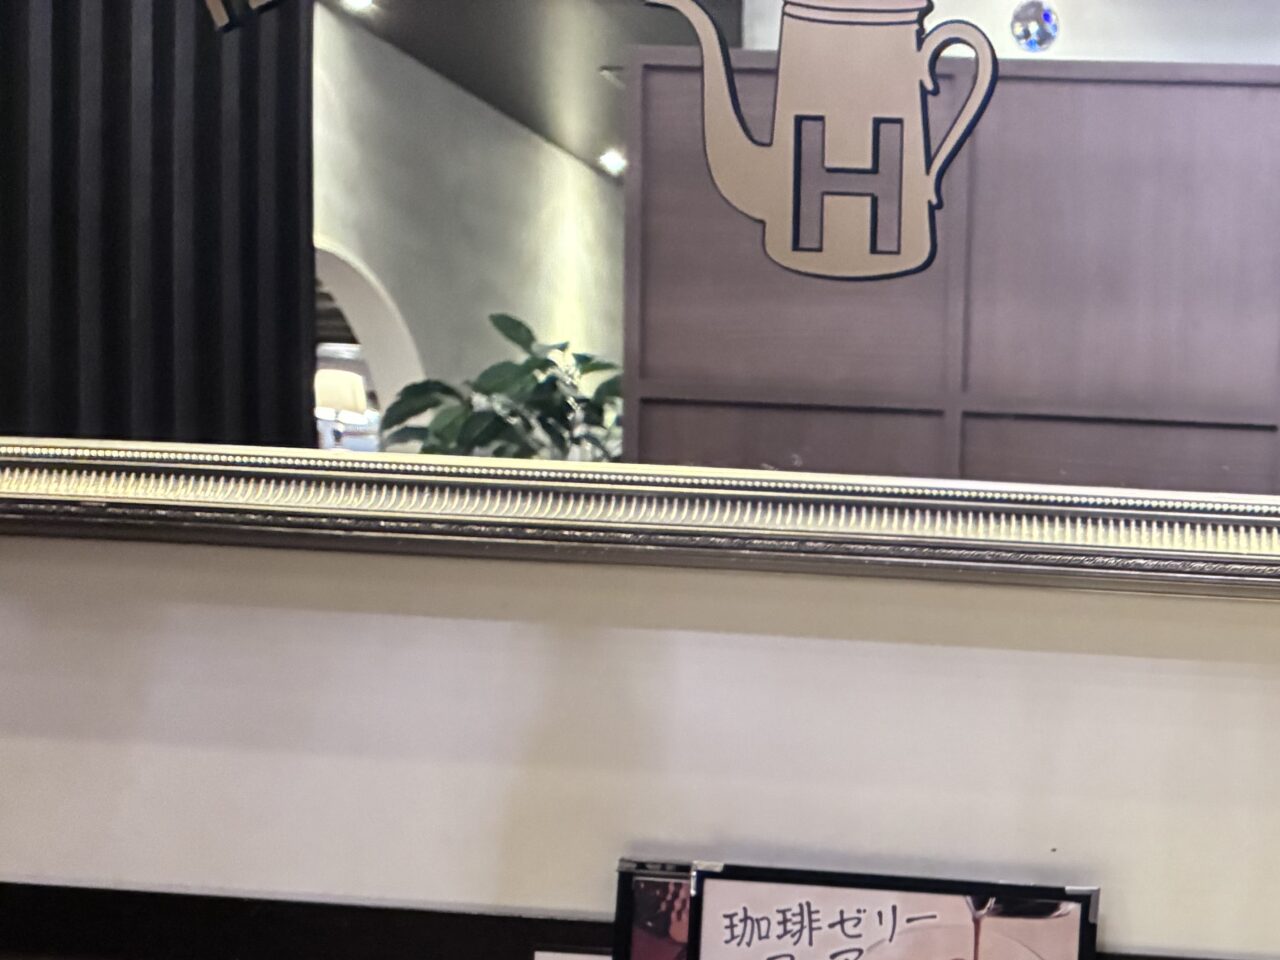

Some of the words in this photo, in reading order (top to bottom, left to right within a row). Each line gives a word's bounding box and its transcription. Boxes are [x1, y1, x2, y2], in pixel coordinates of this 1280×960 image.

[722, 901, 938, 948] 珈琲ゼリー
